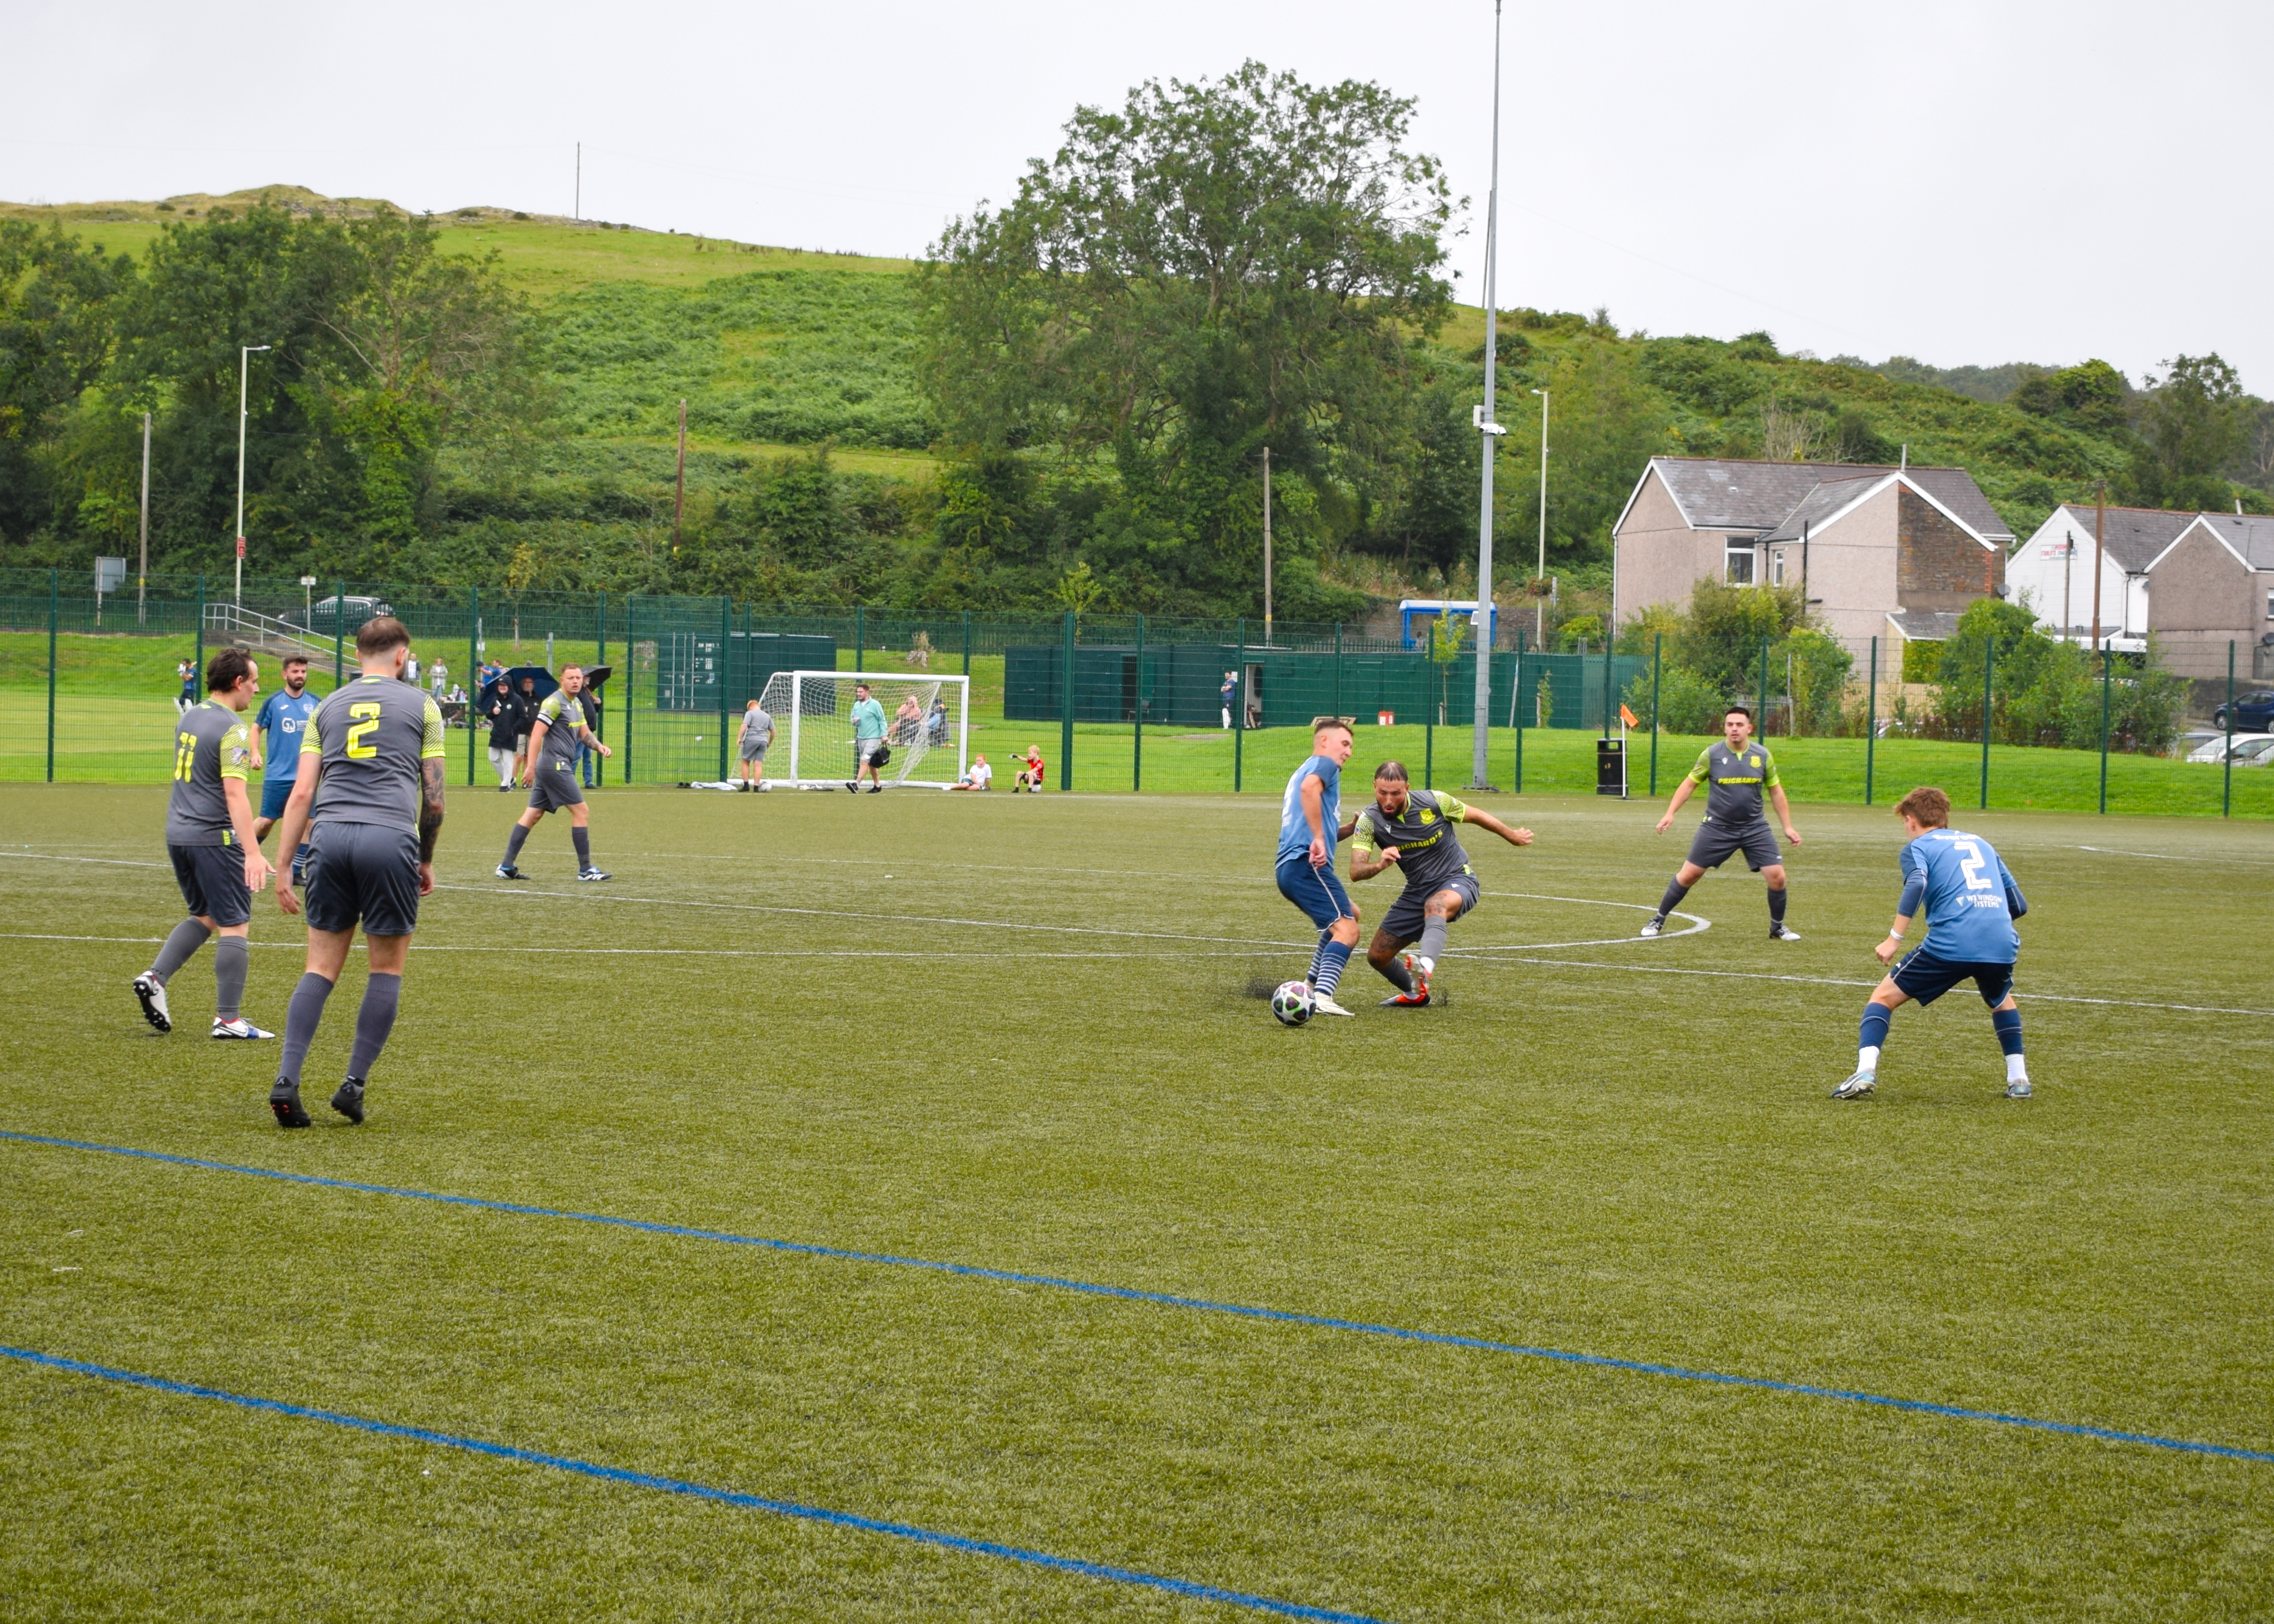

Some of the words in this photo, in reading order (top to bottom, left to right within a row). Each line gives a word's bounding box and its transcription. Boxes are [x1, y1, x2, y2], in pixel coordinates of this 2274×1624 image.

[347, 703, 381, 759] 2
[174, 732, 197, 784] 11
[1953, 841, 1992, 889] 2
